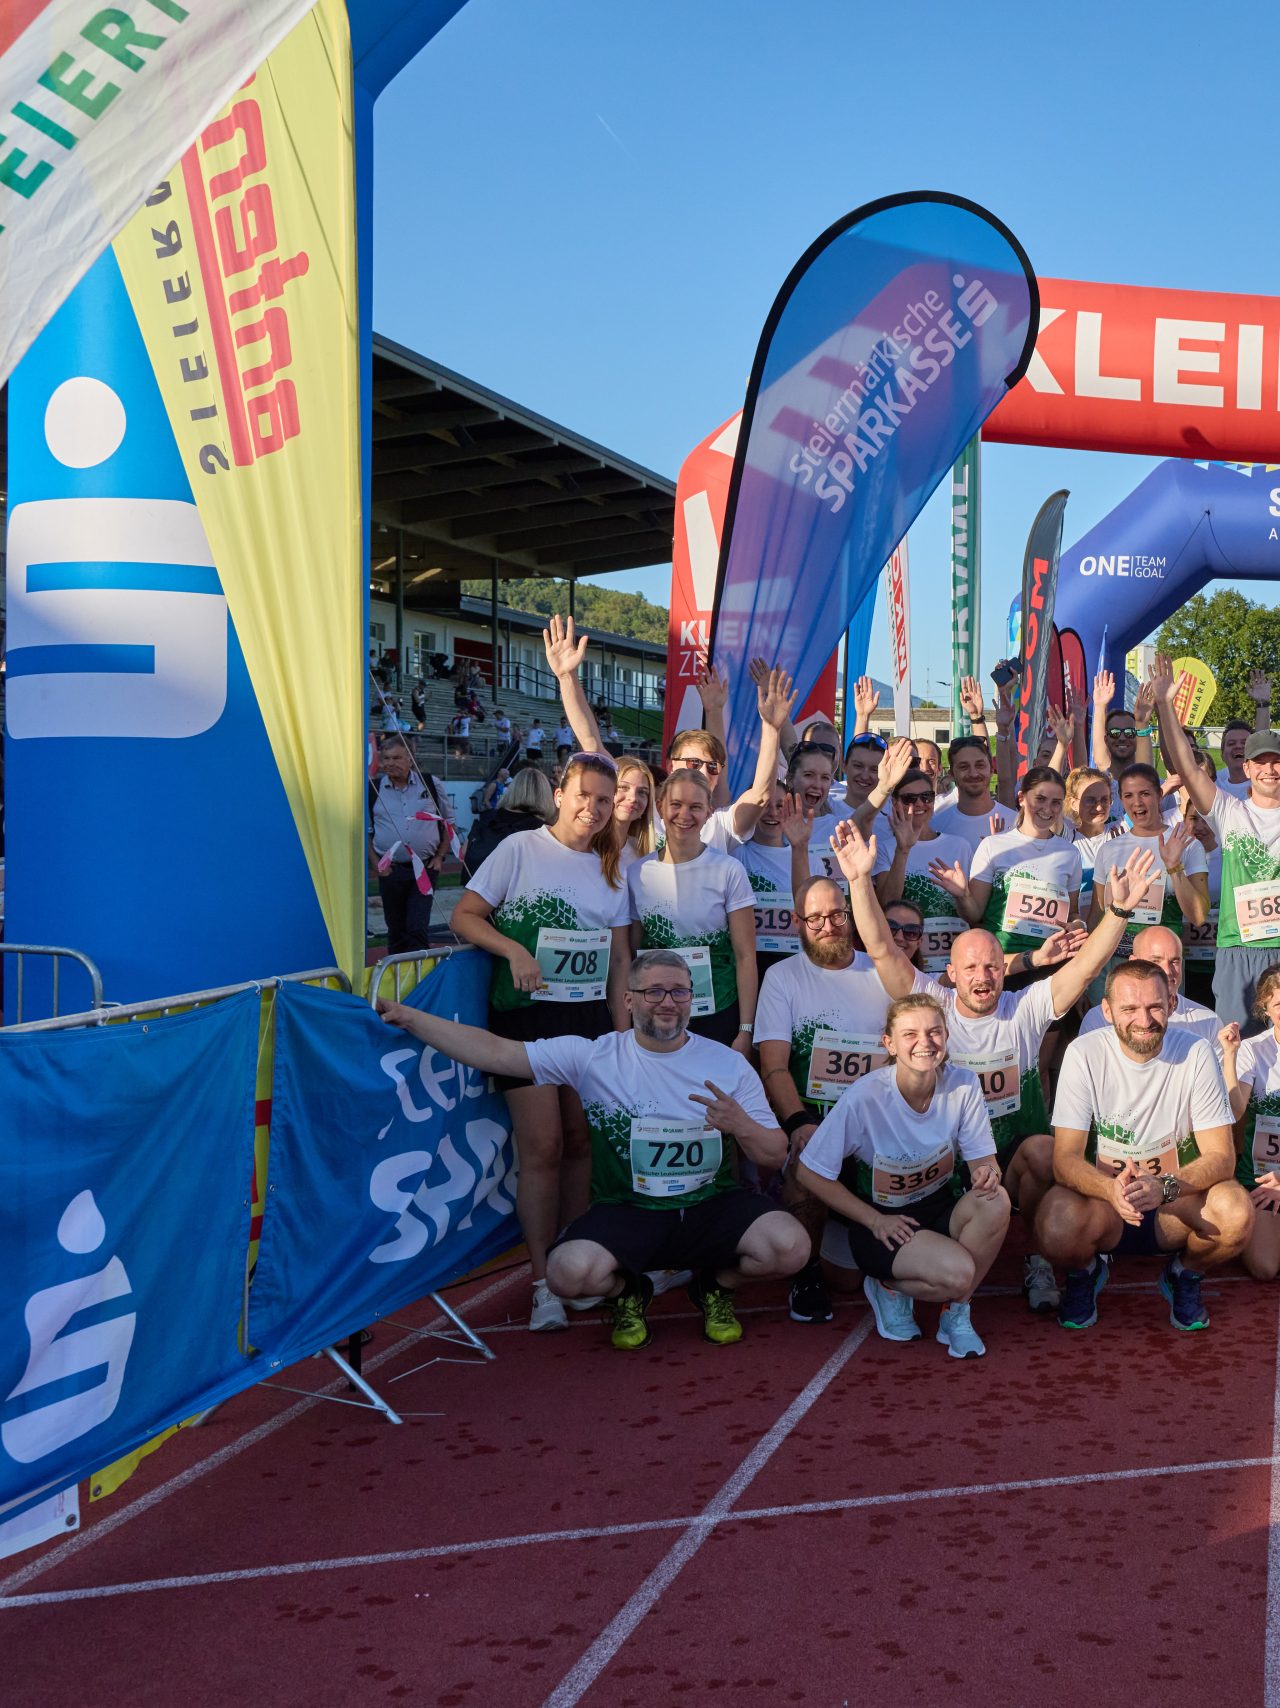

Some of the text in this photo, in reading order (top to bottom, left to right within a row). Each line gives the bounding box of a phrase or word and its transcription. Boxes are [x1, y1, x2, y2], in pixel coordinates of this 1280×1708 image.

[788, 289, 945, 484] Steiermärkische
[814, 308, 973, 514] SPARKASSE
[1079, 555, 1166, 577] ONE TEAM
[1135, 567, 1165, 578] GOAL
[1019, 894, 1059, 919] 520
[928, 932, 958, 951] 53
[553, 950, 598, 976] 708
[825, 1051, 872, 1077] 361
[647, 1141, 704, 1168] 720
[889, 1162, 939, 1191] 336
